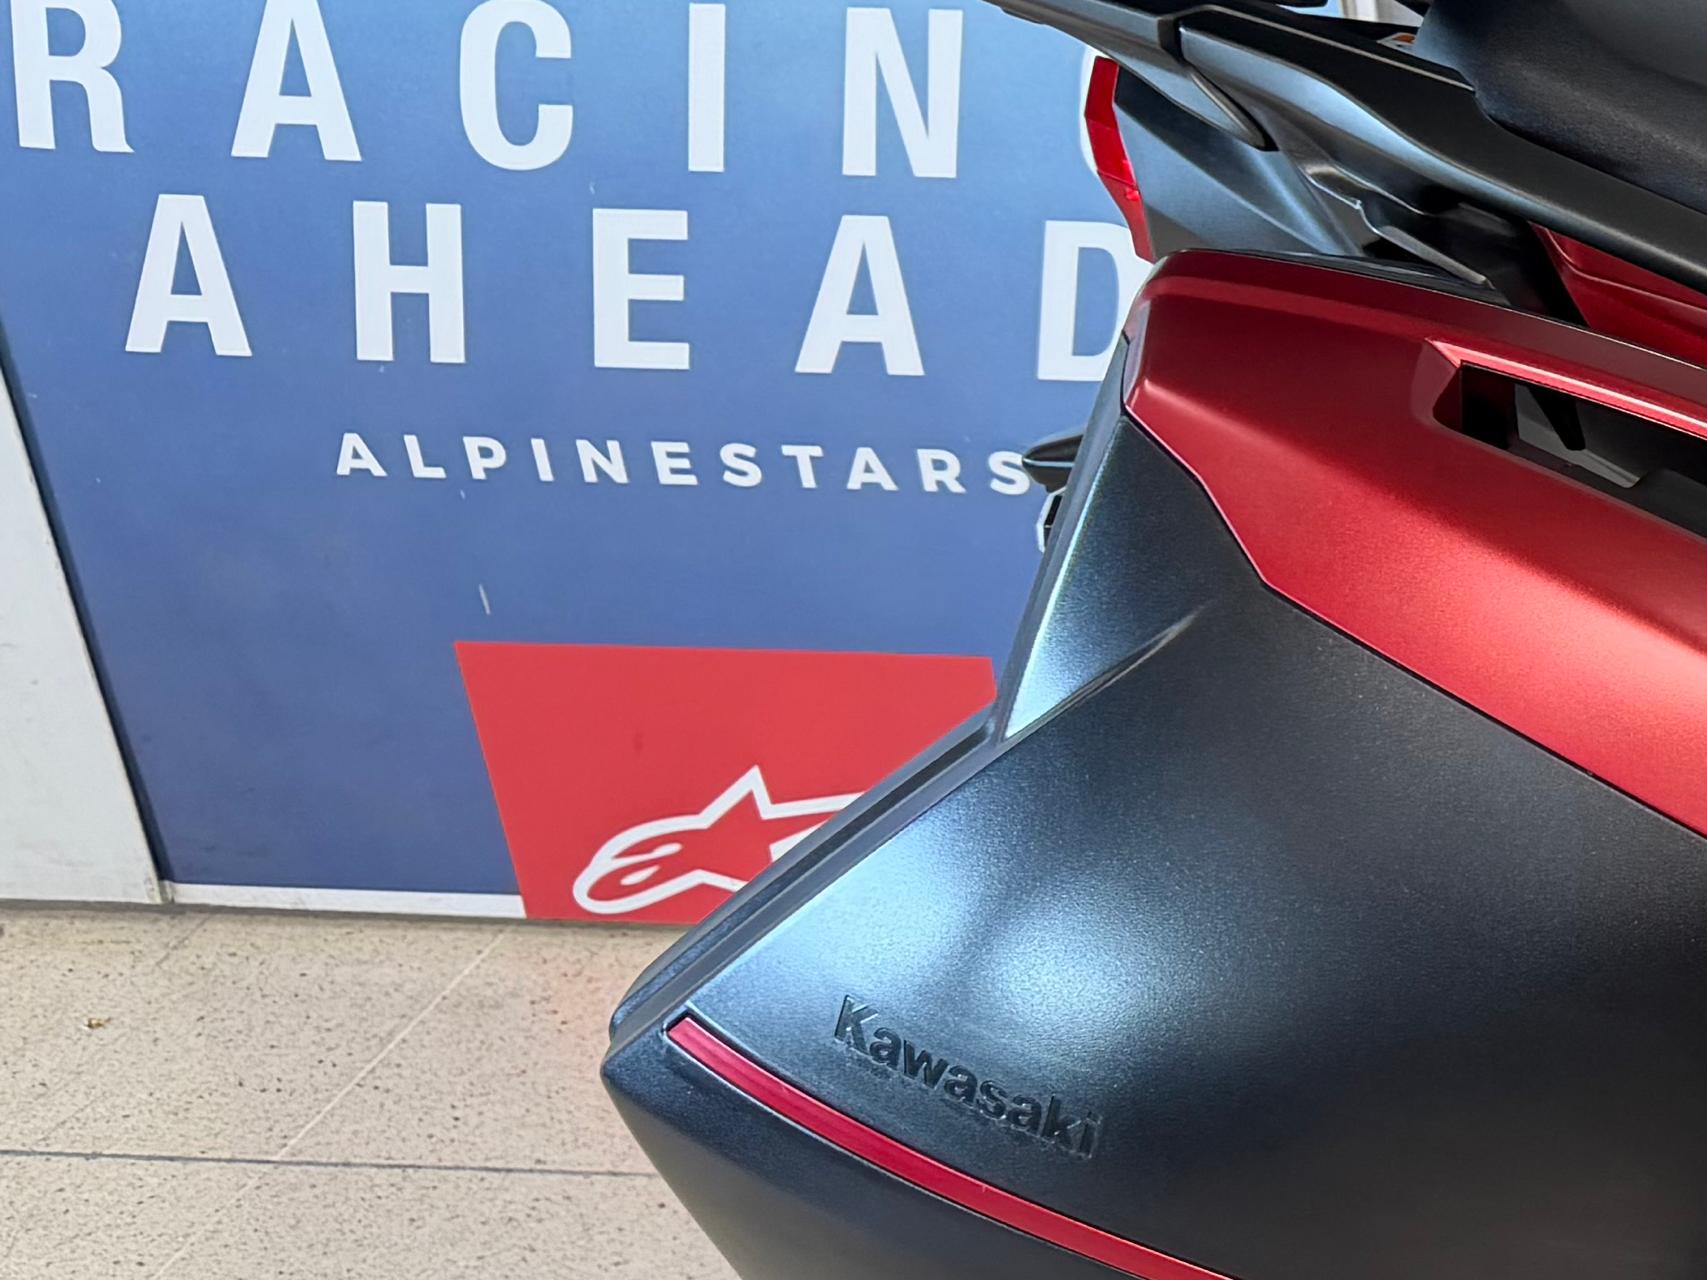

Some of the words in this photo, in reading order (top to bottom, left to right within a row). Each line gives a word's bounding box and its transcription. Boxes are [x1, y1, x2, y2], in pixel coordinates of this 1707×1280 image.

[125, 194, 1152, 382] AHEAD
[336, 432, 1031, 495] ALPINESTARS
[833, 995, 1101, 1159] Kawasaki
